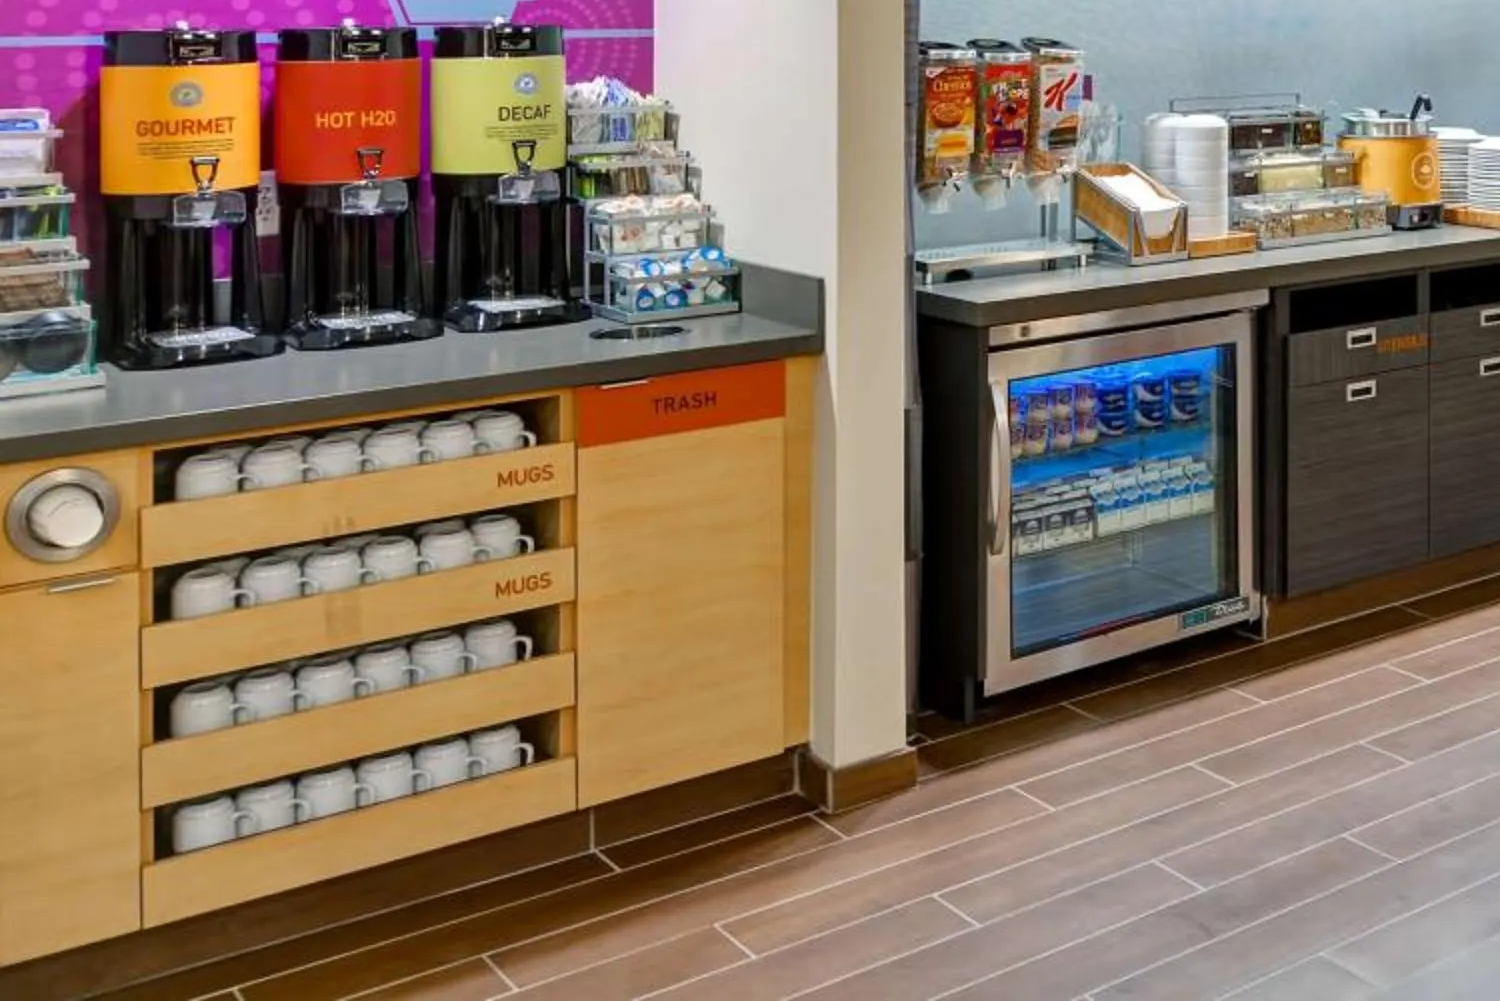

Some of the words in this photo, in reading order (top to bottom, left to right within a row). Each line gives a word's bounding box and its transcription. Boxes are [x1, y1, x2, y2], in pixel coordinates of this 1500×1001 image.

[315, 110, 356, 129] HOT
[497, 104, 552, 123] DECAF
[135, 116, 237, 138] GOURMET
[653, 392, 718, 416] TRASH
[496, 464, 555, 489] MUGS
[495, 571, 554, 599] MUGS
